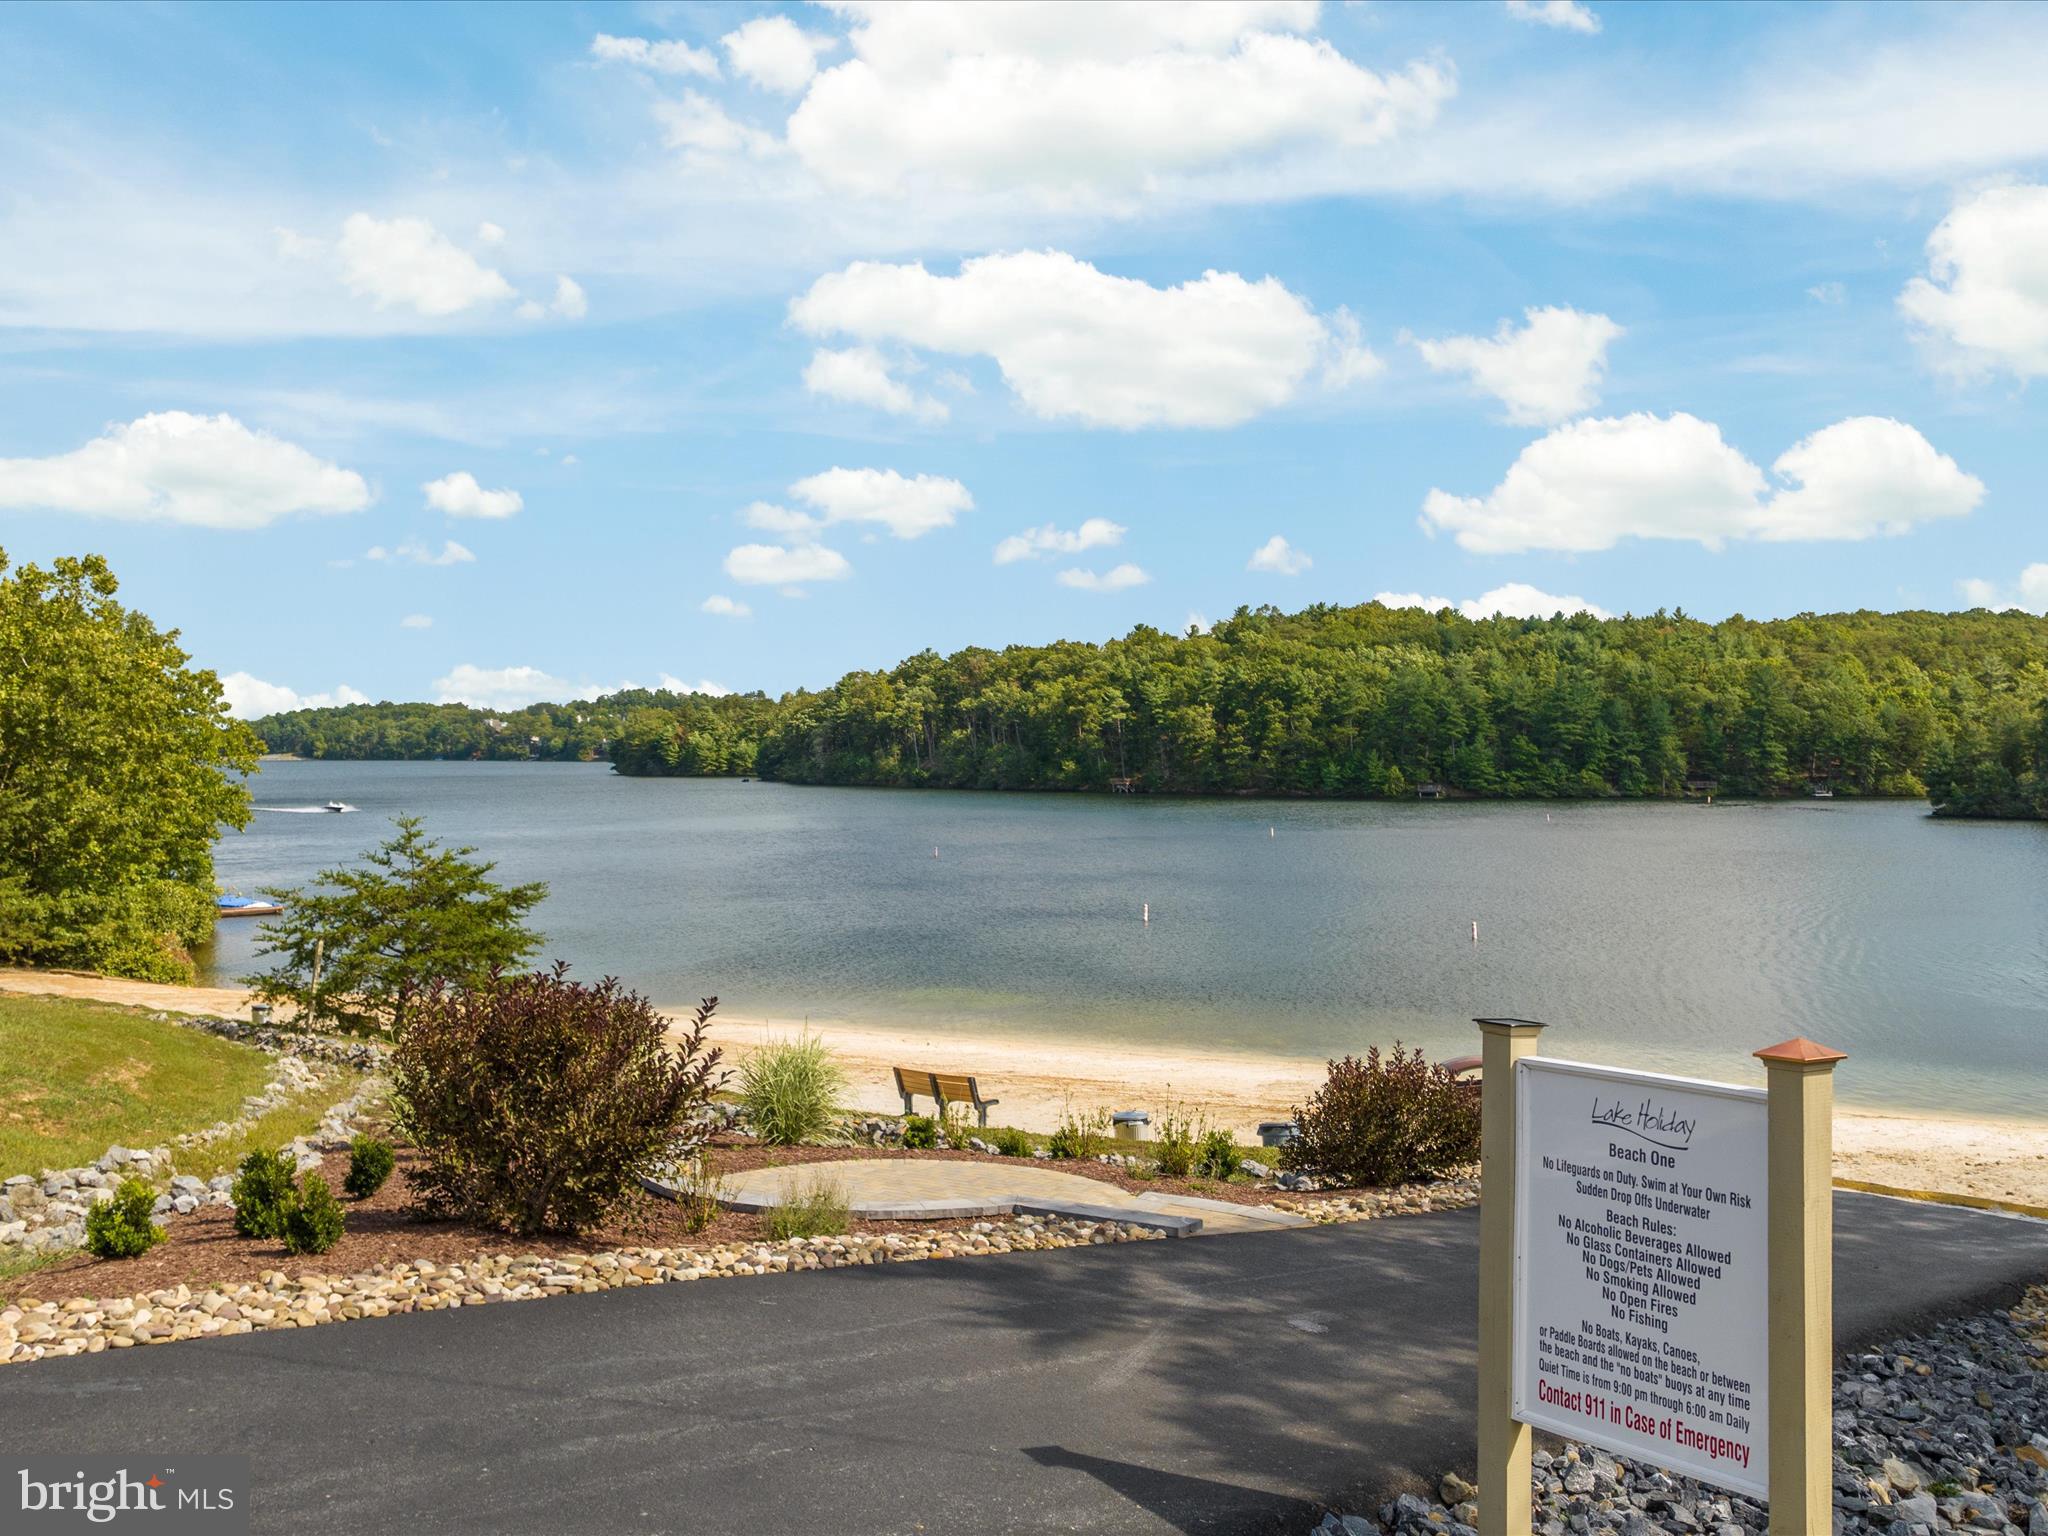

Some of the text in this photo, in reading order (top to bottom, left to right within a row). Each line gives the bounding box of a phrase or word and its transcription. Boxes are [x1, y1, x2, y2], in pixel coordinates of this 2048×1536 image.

[1591, 1097, 1696, 1143] Lake Holiday
[1608, 1142, 1676, 1169] Beach One
[1542, 1155, 1752, 1209] No Lifeguards on Duty. Swim at Your Own Risk
[1575, 1179, 1711, 1221] Sudden Drop Offs Underwater
[1558, 1213, 1732, 1266] No Alcoholic Beverages Allowed
[1606, 1208, 1677, 1237] Beach Rules:
[1566, 1231, 1722, 1280] No Glass Containers Allowed
[1582, 1249, 1701, 1291] No Dogs/Pets Allowed
[1585, 1265, 1697, 1306] No Smoking Allowed
[1602, 1285, 1679, 1318] No Open Fires
[1611, 1303, 1668, 1334] No Fishing
[1539, 1325, 1751, 1395] or Paddle Boards allowed on the beach or between
[1581, 1319, 1701, 1366] No Boats, Kayaks, Canoes,
[1538, 1357, 1750, 1435] Quiet Time is from 9:00 pm through 6:00 am Daily
[1539, 1339, 1553, 1355] the
[1554, 1343, 1580, 1363] beach
[1582, 1353, 1598, 1368] and
[1600, 1356, 1615, 1373] the
[1665, 1374, 1693, 1396] buoys
[1695, 1385, 1706, 1399] at
[1707, 1389, 1726, 1406] any
[1727, 1392, 1751, 1411] time
[1538, 1378, 1750, 1469] Contact 911 in Case of Emergency
